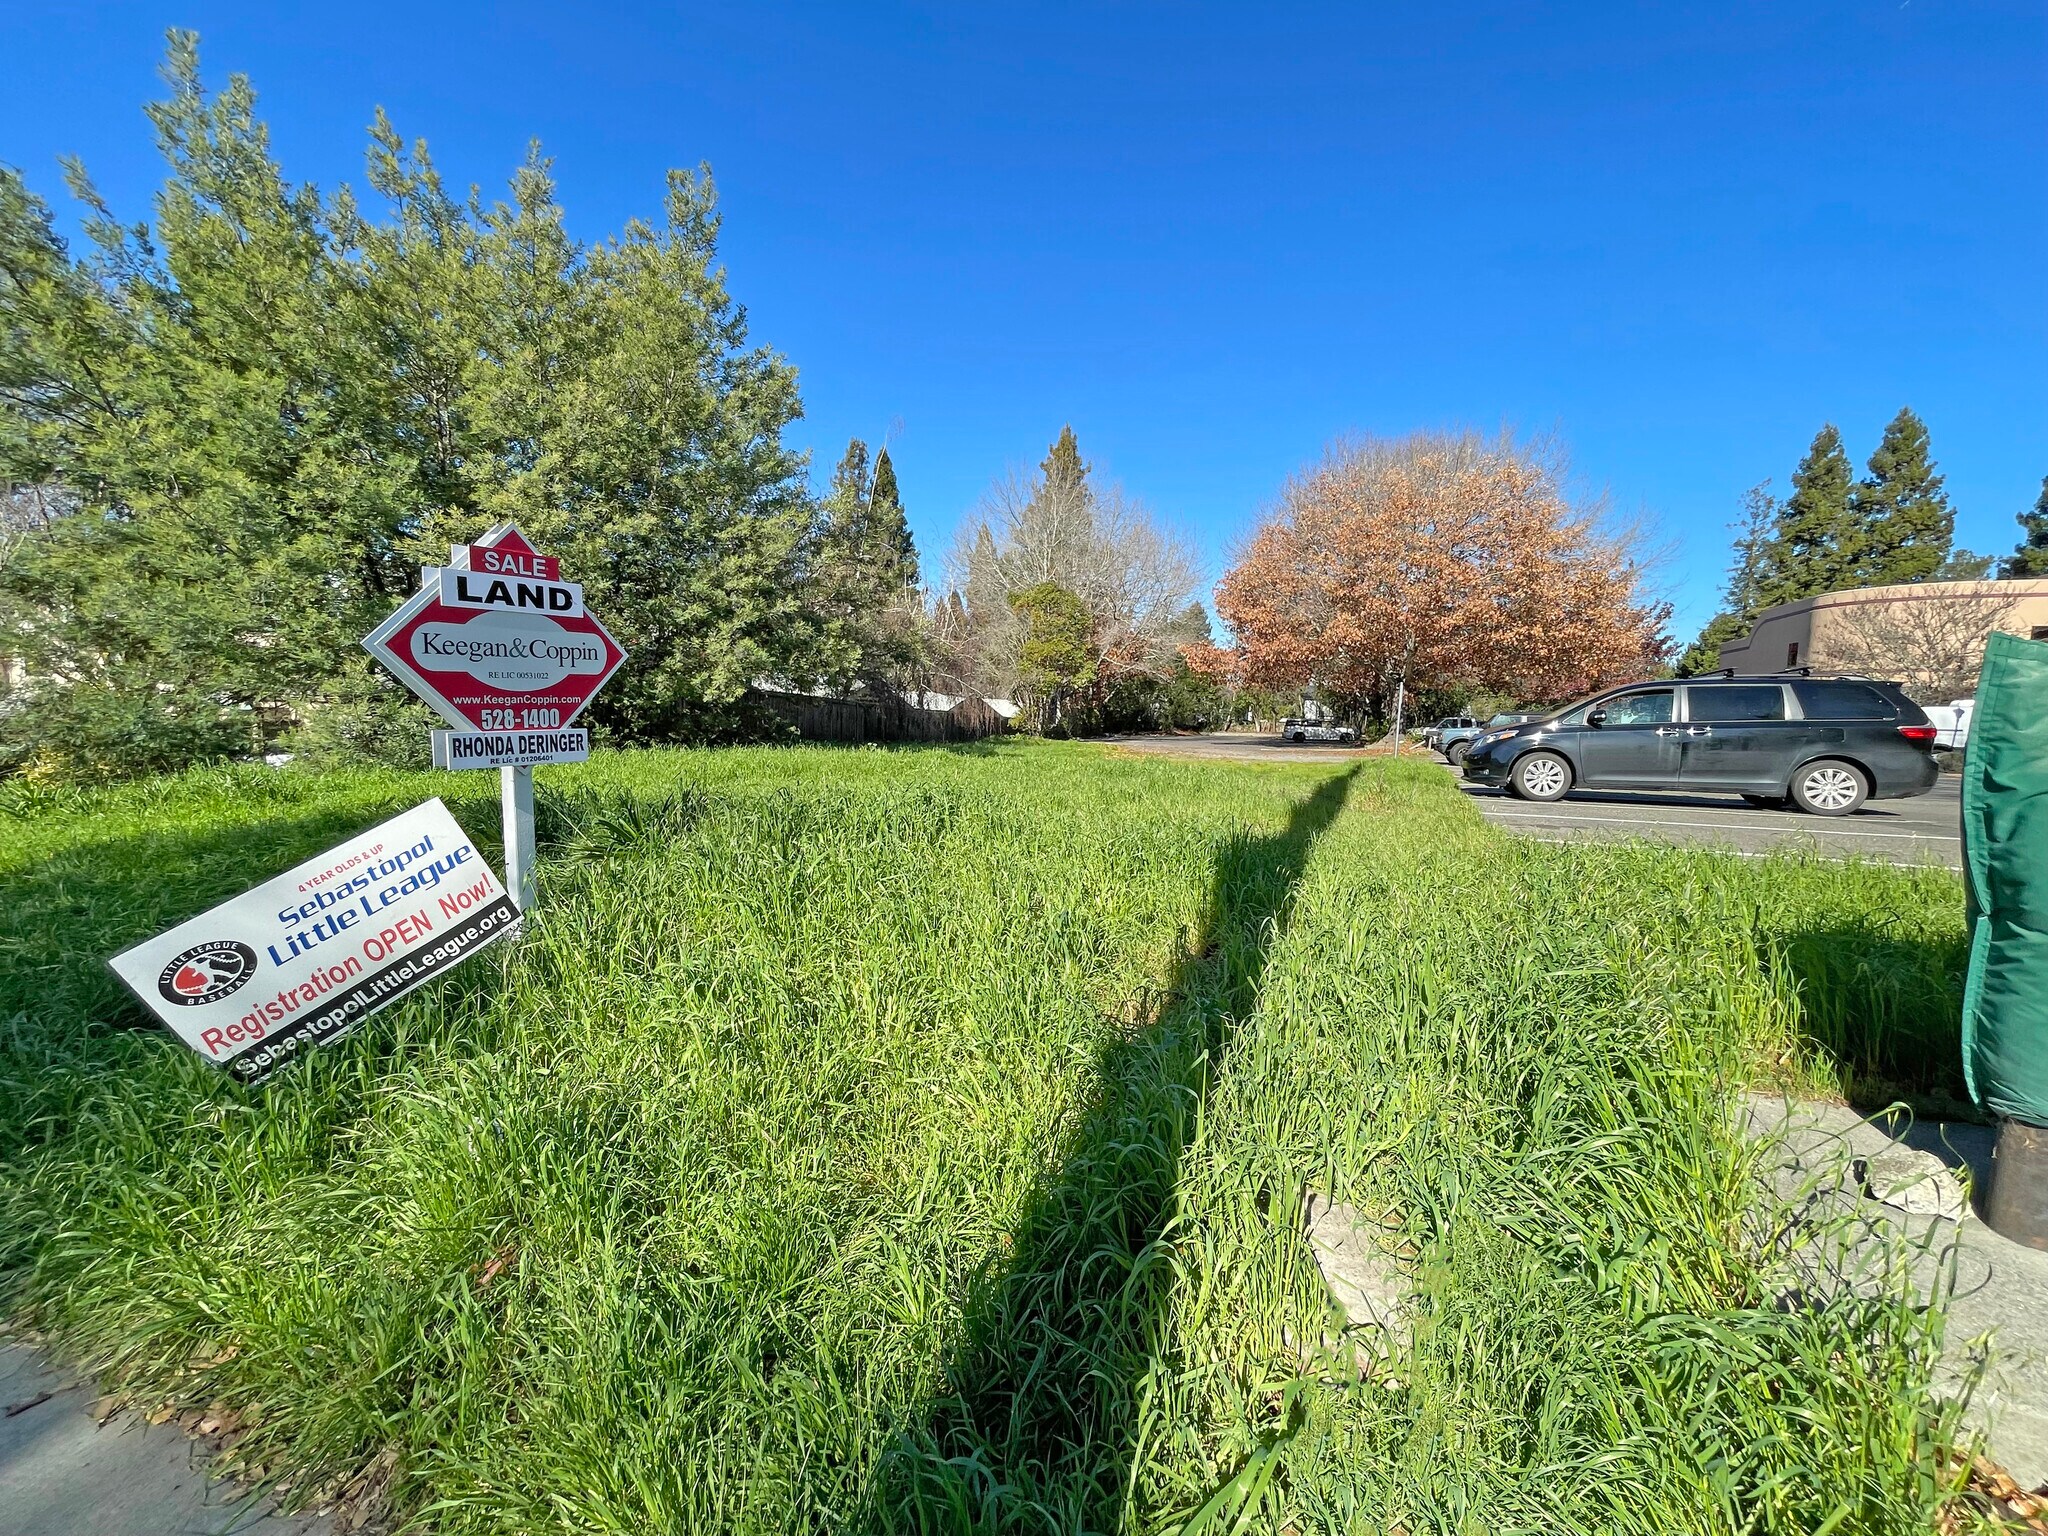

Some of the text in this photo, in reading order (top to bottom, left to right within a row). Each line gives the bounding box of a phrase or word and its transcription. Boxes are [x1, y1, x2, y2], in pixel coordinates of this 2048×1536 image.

[484, 551, 547, 578] SALE
[457, 576, 573, 611] LAND
[516, 672, 549, 680] 00531022
[453, 695, 581, 706] www.KeeganCoppin.com
[481, 708, 560, 730] 528-1400
[452, 733, 585, 758] RHONDA DERINGER
[278, 834, 435, 930] Sebastopol
[298, 843, 384, 893] 4 YEAR OLDS & UP
[267, 844, 473, 967] Little League
[160, 942, 239, 984] LITTLE LEAGUE
[200, 872, 494, 1055] Registration OPEN Now!
[187, 969, 254, 1005] BASEBALL
